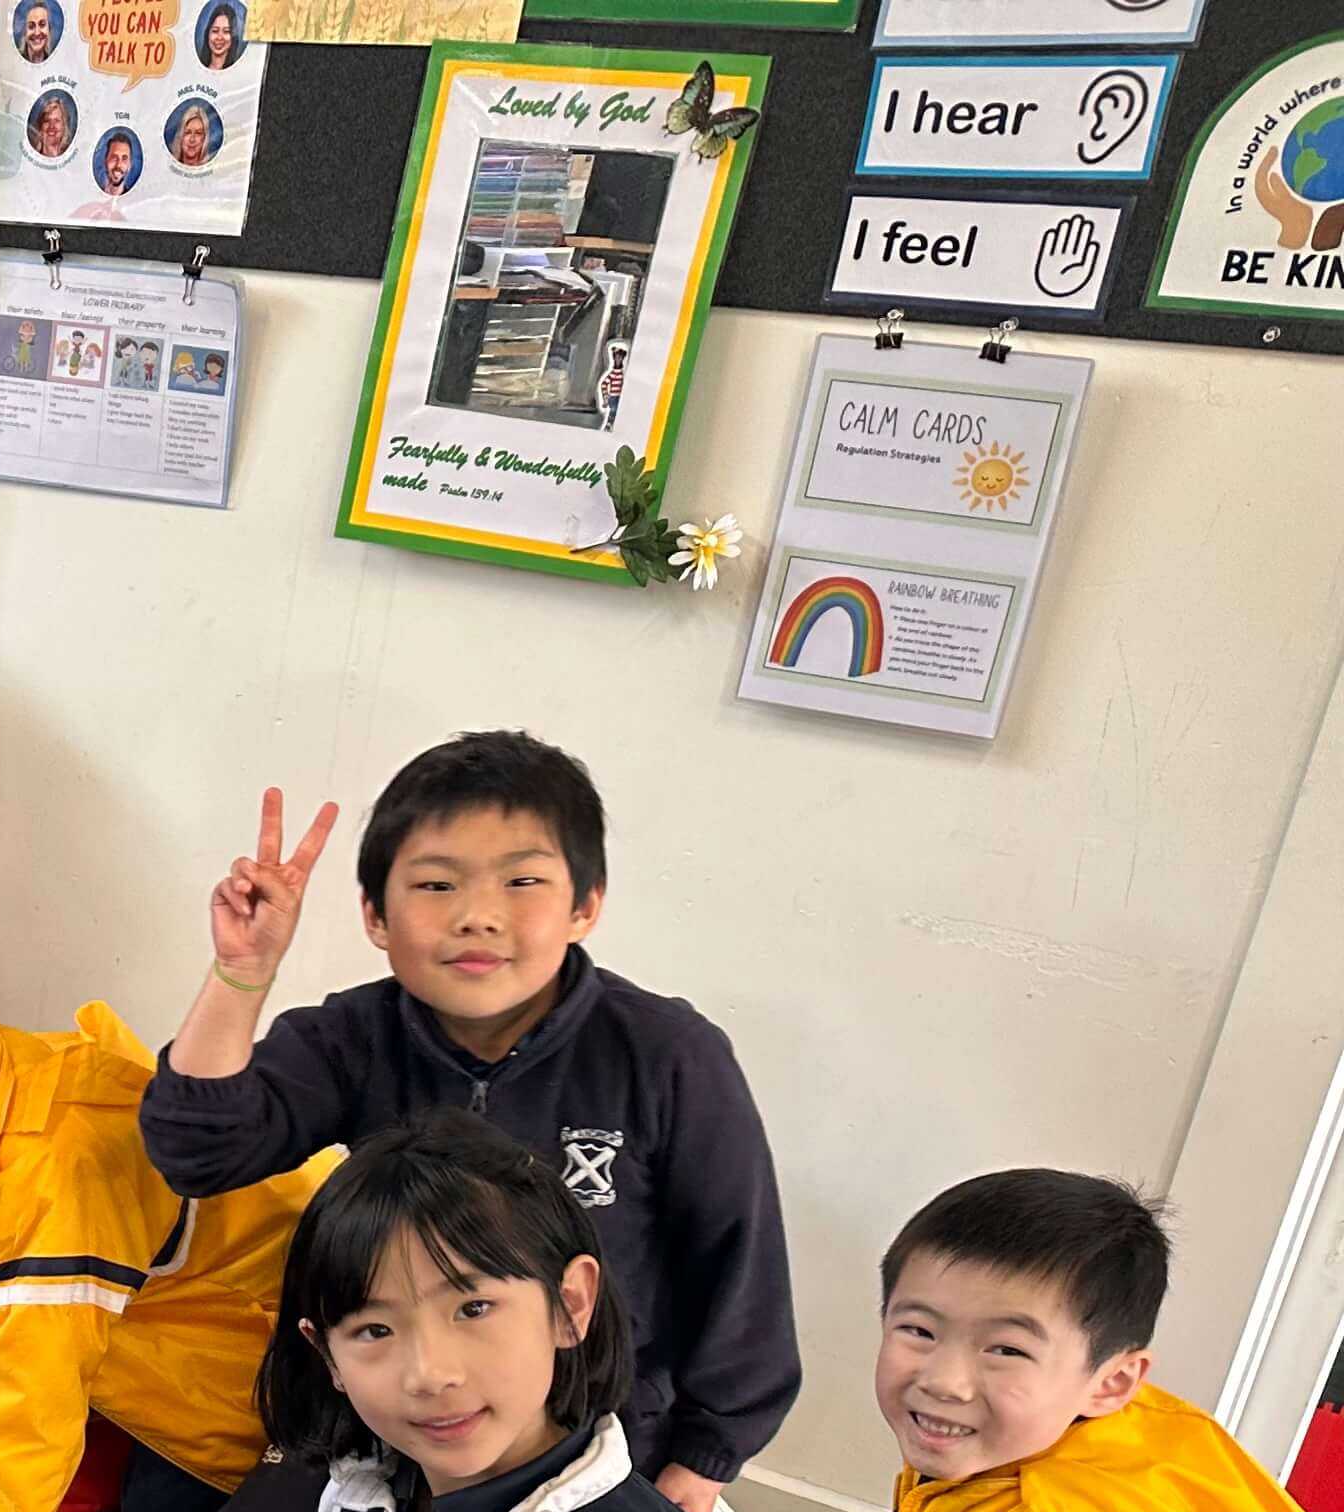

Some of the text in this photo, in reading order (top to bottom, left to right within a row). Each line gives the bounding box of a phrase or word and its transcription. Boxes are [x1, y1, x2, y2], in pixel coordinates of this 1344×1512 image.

[88, 11, 162, 37] YOU CAN
[97, 41, 165, 65] TALK TO
[488, 86, 656, 131] Loved by God
[884, 90, 1038, 135] I hear
[1225, 76, 1342, 214] In a world where
[853, 219, 978, 268] I feel
[1220, 249, 1275, 284] BE
[83, 297, 146, 312] LOWER PRIMARY
[135, 320, 166, 330] property
[839, 401, 987, 445] CALM CARDS
[388, 436, 604, 488] Fearfully & Wonderfully
[836, 442, 941, 463] Regulation Strategies
[382, 472, 429, 492] made
[439, 483, 468, 498] Psalm
[888, 581, 1000, 608] RAINBOW BREATHING
